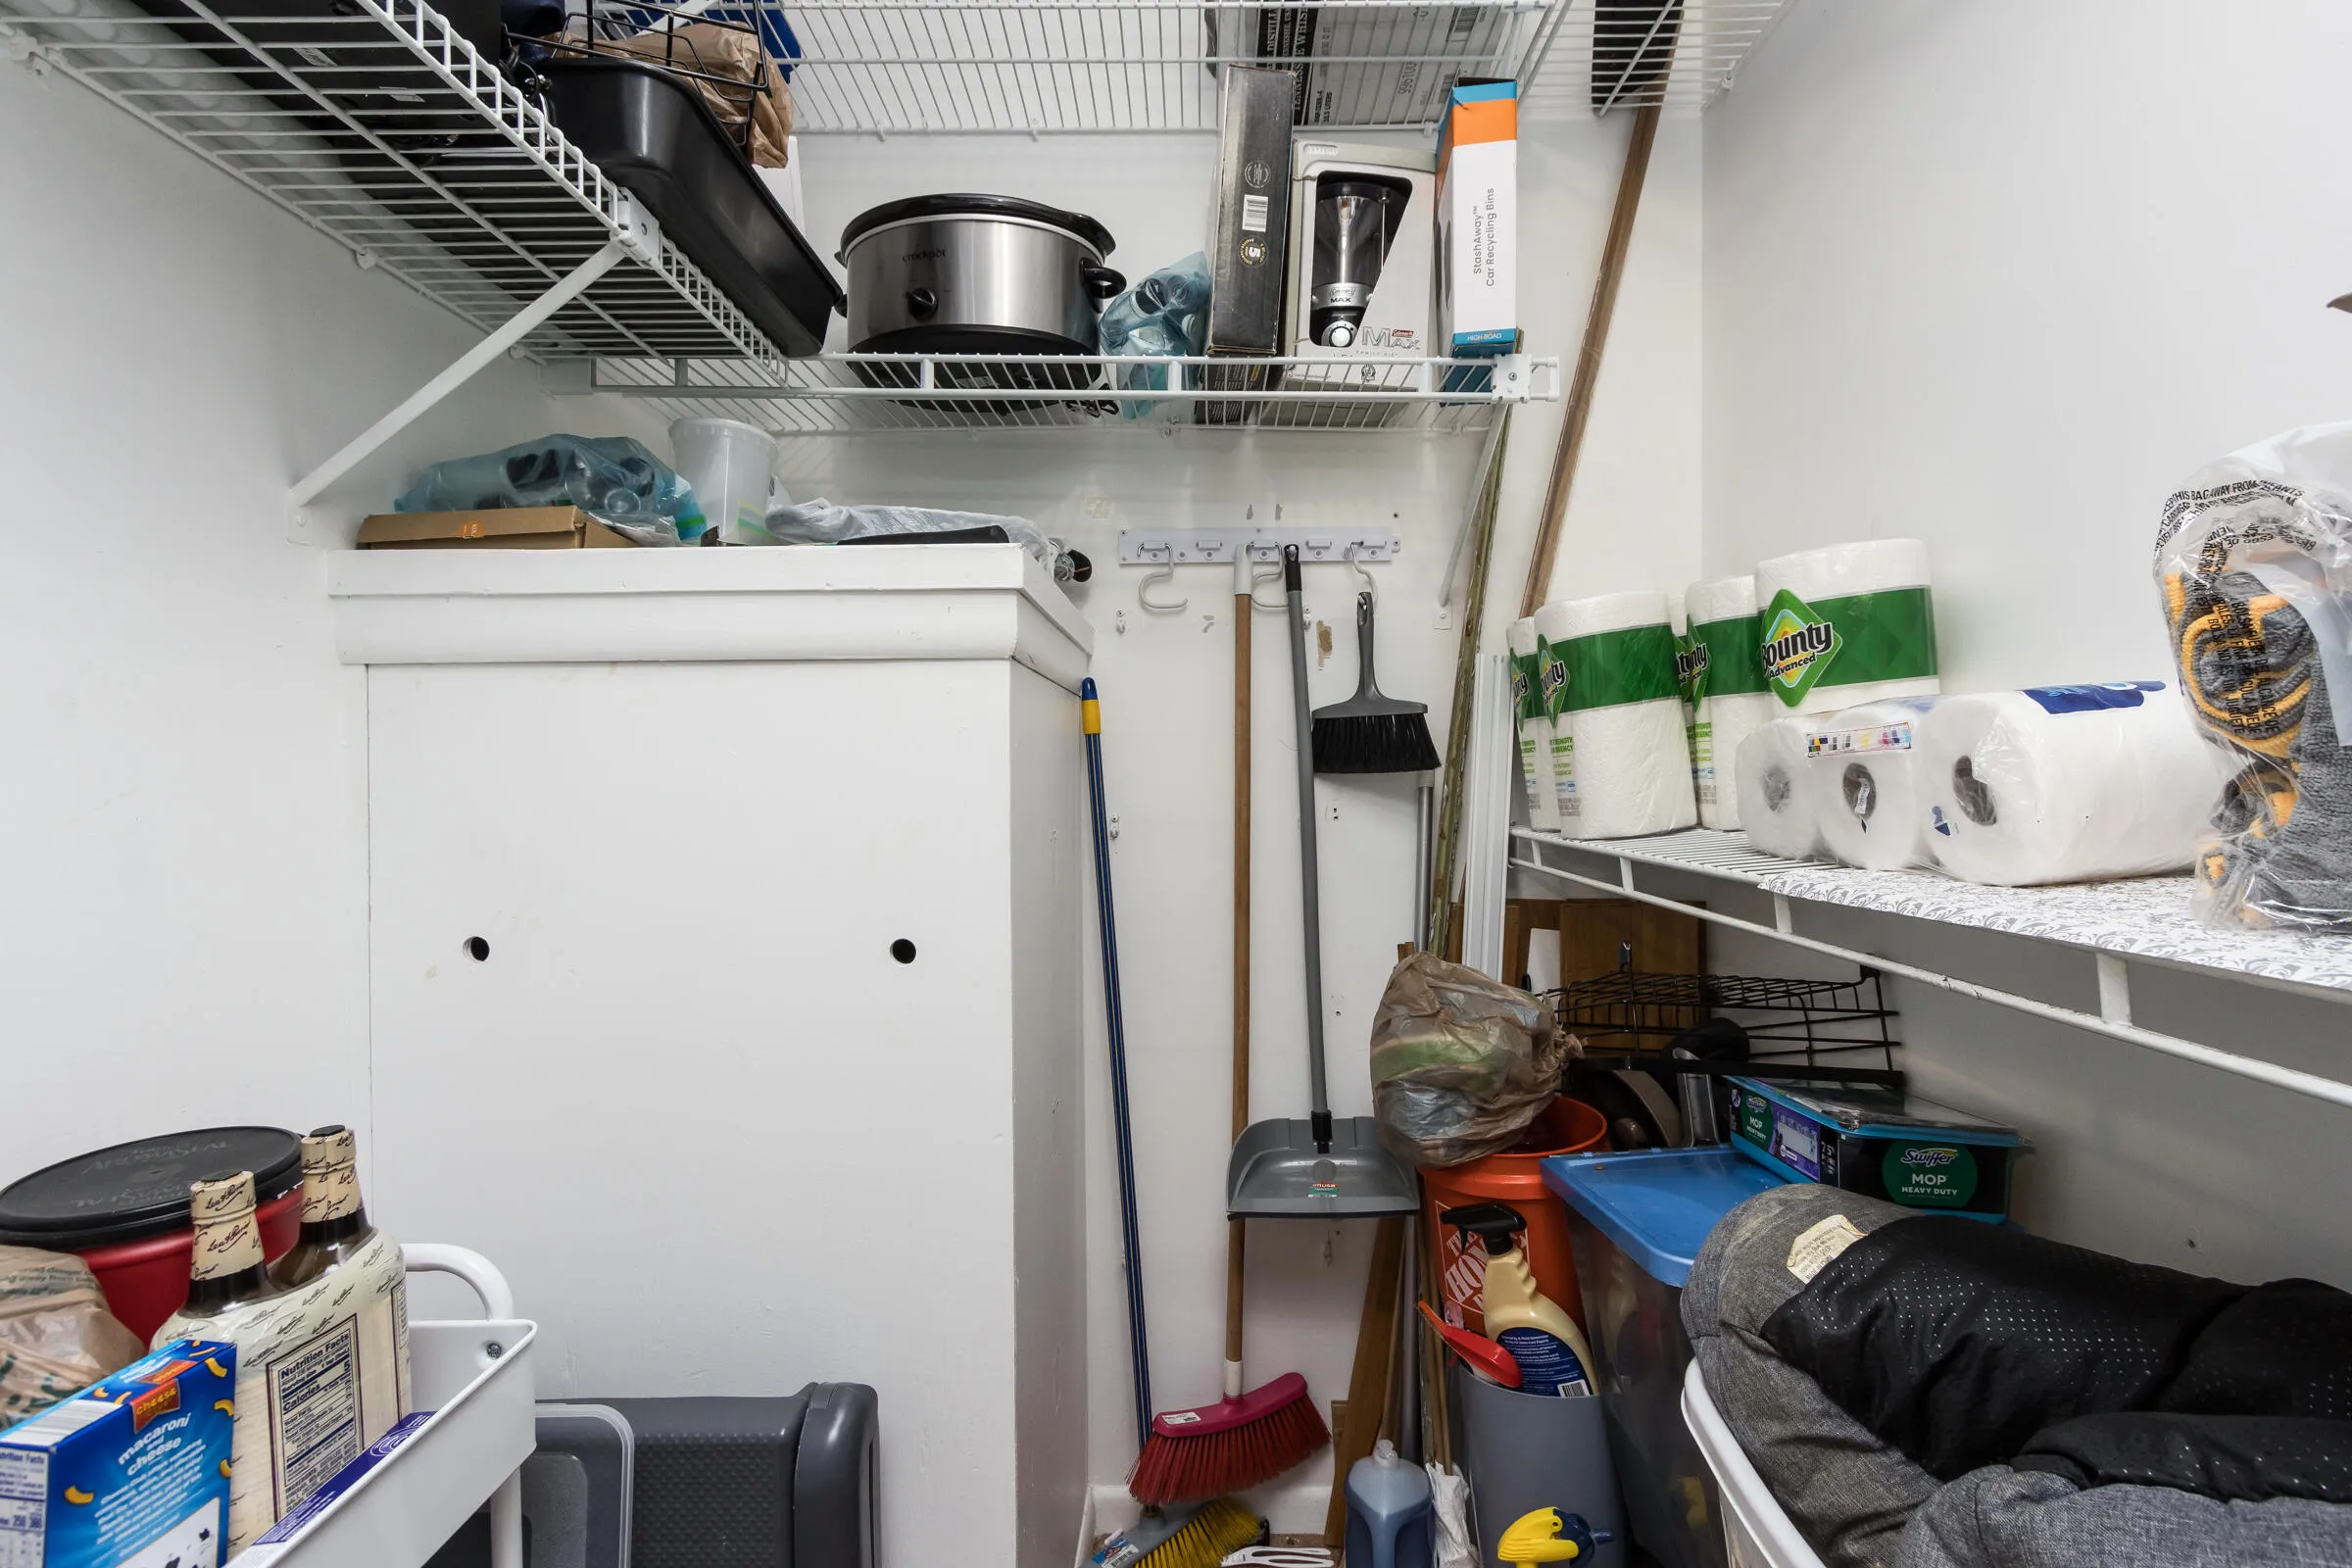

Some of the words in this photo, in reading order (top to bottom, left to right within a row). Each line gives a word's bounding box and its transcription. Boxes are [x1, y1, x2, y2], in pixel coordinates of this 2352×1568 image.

[1267, 8, 1278, 51] DISTILL
[1294, 47, 1305, 110] TENNESSE
[1486, 213, 1497, 263] Recycling
[1486, 269, 1494, 286] Car
[2173, 490, 2190, 502] THIS
[2231, 480, 2259, 492] FROM
[1769, 654, 1816, 678] Advanced
[2258, 677, 2278, 719] ALCANCE
[1749, 1116, 1763, 1129] MOP
[1901, 1149, 1956, 1167] Swiffer
[1901, 1186, 1932, 1195] HEAVY
[1934, 1188, 1958, 1197] DUTY
[1912, 1174, 1946, 1186] MOP
[280, 1349, 323, 1379] Nutrition
[324, 1334, 349, 1352] Facts
[282, 1384, 320, 1411] Calories
[343, 1359, 351, 1371] 5
[136, 1387, 177, 1415] cheese
[118, 1412, 192, 1465] macaroni
[146, 1435, 165, 1451] and
[126, 1437, 182, 1476] cheese
